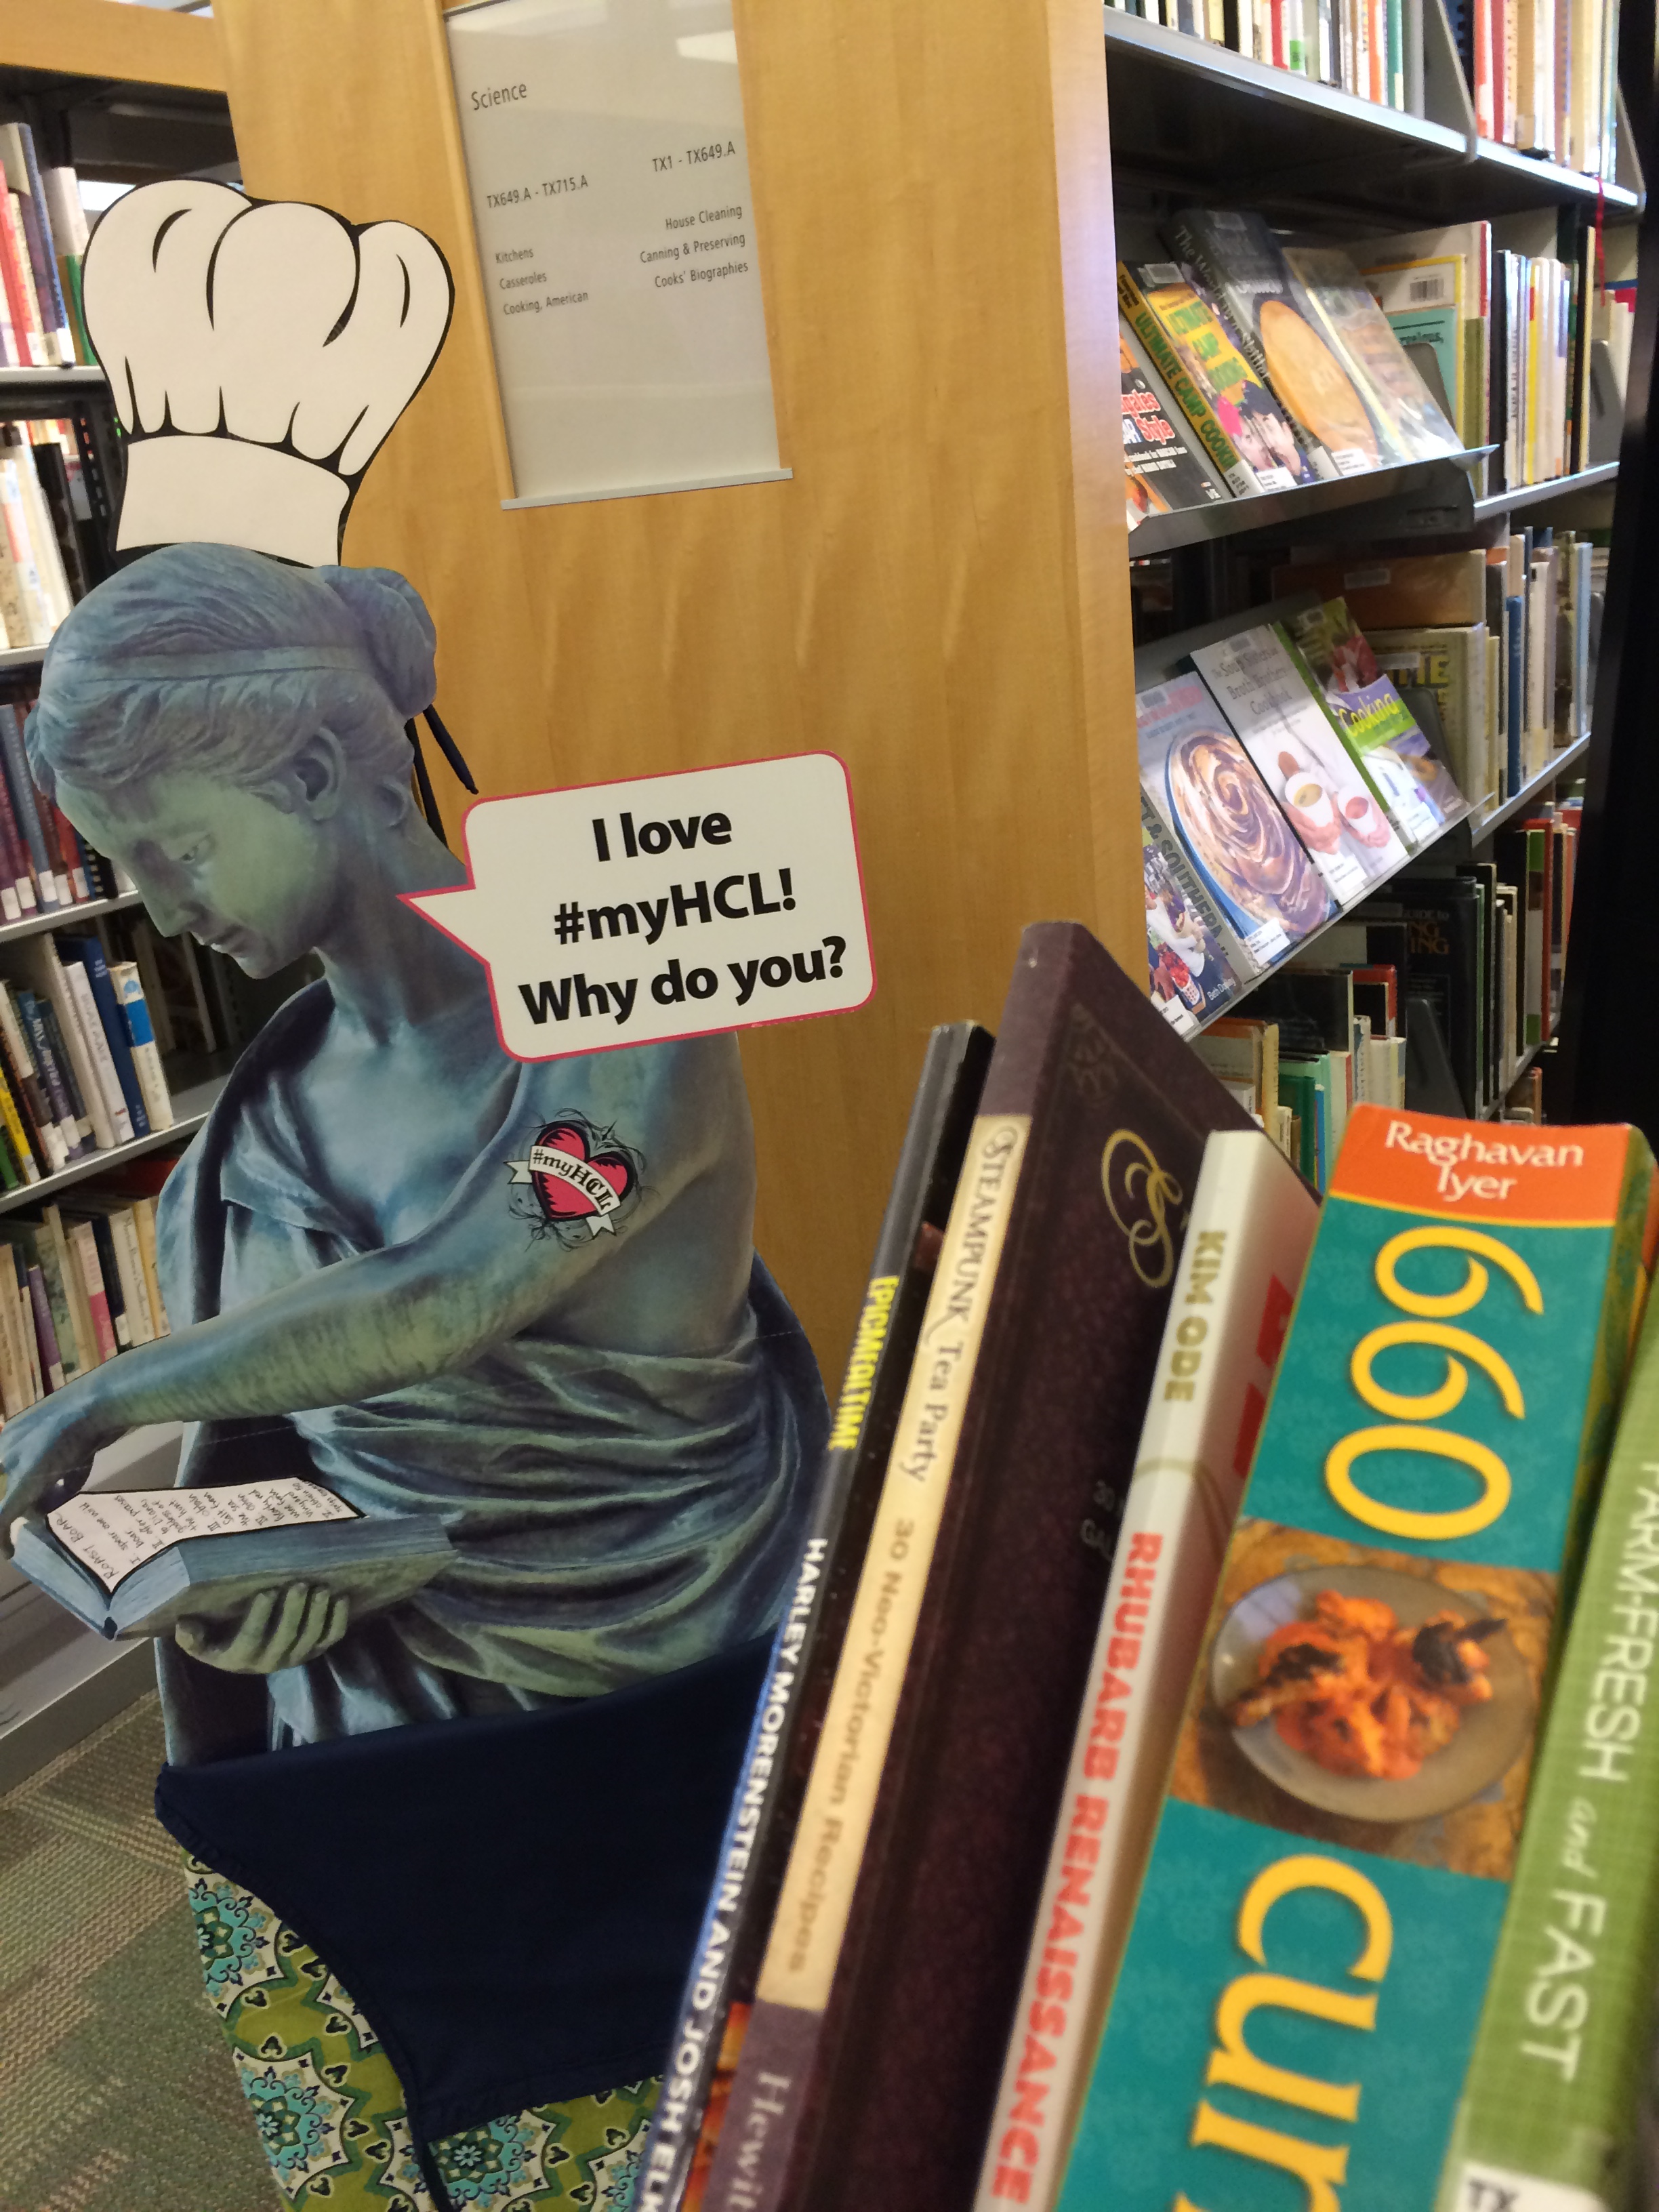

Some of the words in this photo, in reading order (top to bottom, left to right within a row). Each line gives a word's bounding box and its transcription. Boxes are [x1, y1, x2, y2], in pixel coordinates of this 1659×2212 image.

[471, 82, 528, 111] Science
[652, 155, 673, 173] TX1
[686, 141, 736, 165] TX649.A
[487, 187, 531, 209] TX649.A
[542, 174, 589, 197] TX715.A
[665, 213, 695, 231] House
[698, 205, 743, 226] Cleaning
[495, 246, 534, 264] Kitchens
[640, 245, 680, 264] Canning
[682, 242, 691, 255] &
[693, 232, 746, 253] Preserving
[499, 270, 548, 290] Casseroles
[654, 270, 687, 289] Cooks'
[689, 260, 749, 283] Biographies
[546, 290, 589, 308] American
[1134, 310, 1183, 380] ULTIMATE
[1174, 376, 1206, 418] CAMP
[1338, 692, 1400, 737] Cooking
[592, 818, 611, 862] I
[619, 812, 732, 858] love
[554, 867, 796, 945] #myHCL!
[518, 972, 638, 1025] Why
[651, 958, 718, 1005] do
[727, 935, 846, 1006] you?
[1385, 1118, 1585, 1168] Raghavan
[532, 1148, 614, 1212] #myHCL
[1436, 1163, 1518, 1203] Iyer
[1185, 1229, 1227, 1307] KIM
[928, 1341, 964, 1392] Tea
[1164, 1314, 1209, 1404] ODE
[1324, 1225, 1545, 1541] 660
[899, 1403, 948, 1482] Party
[79, 1502, 99, 1517] wild
[114, 1495, 140, 1517] praises
[152, 1499, 164, 1509] of
[168, 1498, 188, 1518] hunt
[203, 1492, 222, 1509] from
[228, 1498, 240, 1512] sea
[248, 1488, 264, 1499] red
[263, 1494, 285, 1522] hearty
[268, 1488, 285, 1507] from
[55, 1512, 84, 1542] BOAR
[96, 1518, 110, 1530] one
[136, 1519, 153, 1535] offer
[162, 1509, 187, 1534] goddess
[186, 1516, 198, 1532] the
[239, 1512, 251, 1526] the
[284, 1504, 300, 1519] wine
[108, 1532, 129, 1551] spear
[125, 1530, 144, 1549] boar
[161, 1526, 169, 1536] to
[890, 1516, 916, 1561] 30
[83, 1544, 119, 1580] ROAST
[778, 1538, 830, 1666] HARLEY
[1084, 1531, 1164, 1782] RHUBARB
[827, 1569, 903, 1807] Neo-Victorian
[717, 1672, 795, 1913] MORENSTEIN
[1561, 1796, 1598, 1880] and
[788, 1816, 844, 1972] Recipes
[691, 1921, 731, 2011] AND
[991, 1793, 1109, 2206] RENAISSANCE
[1521, 1888, 1608, 2083] FAST
[660, 2020, 704, 2134] JOSH
